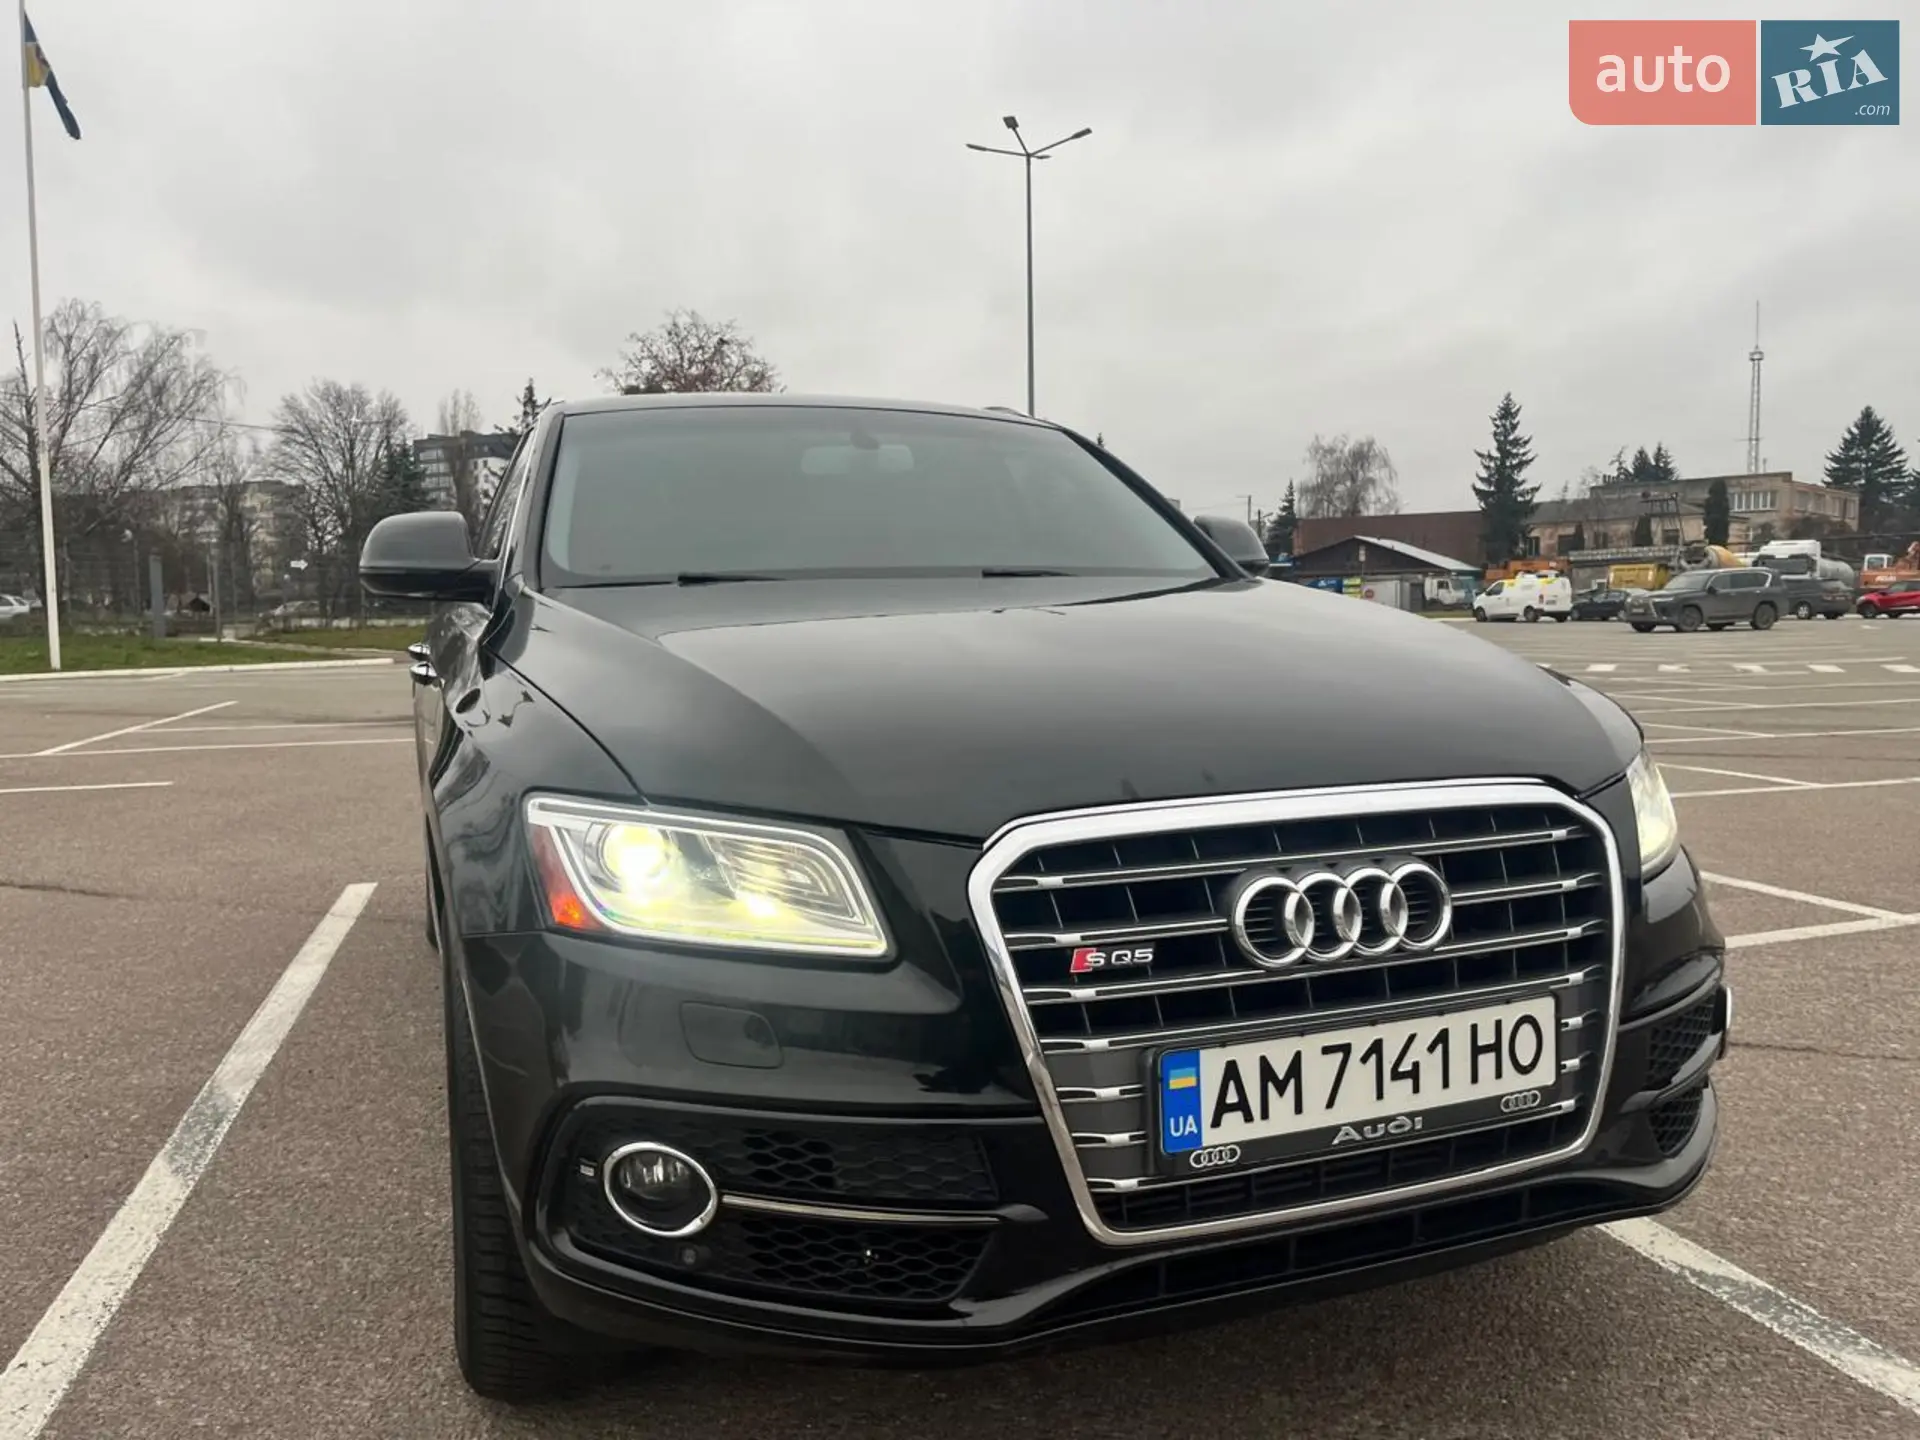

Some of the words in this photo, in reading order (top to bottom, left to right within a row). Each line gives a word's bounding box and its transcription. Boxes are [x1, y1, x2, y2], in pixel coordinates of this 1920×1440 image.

[1210, 1048, 1304, 1130] AM
[1321, 1027, 1451, 1110] 7141
[1470, 1013, 1544, 1086] HO
[1169, 1114, 1199, 1138] UA
